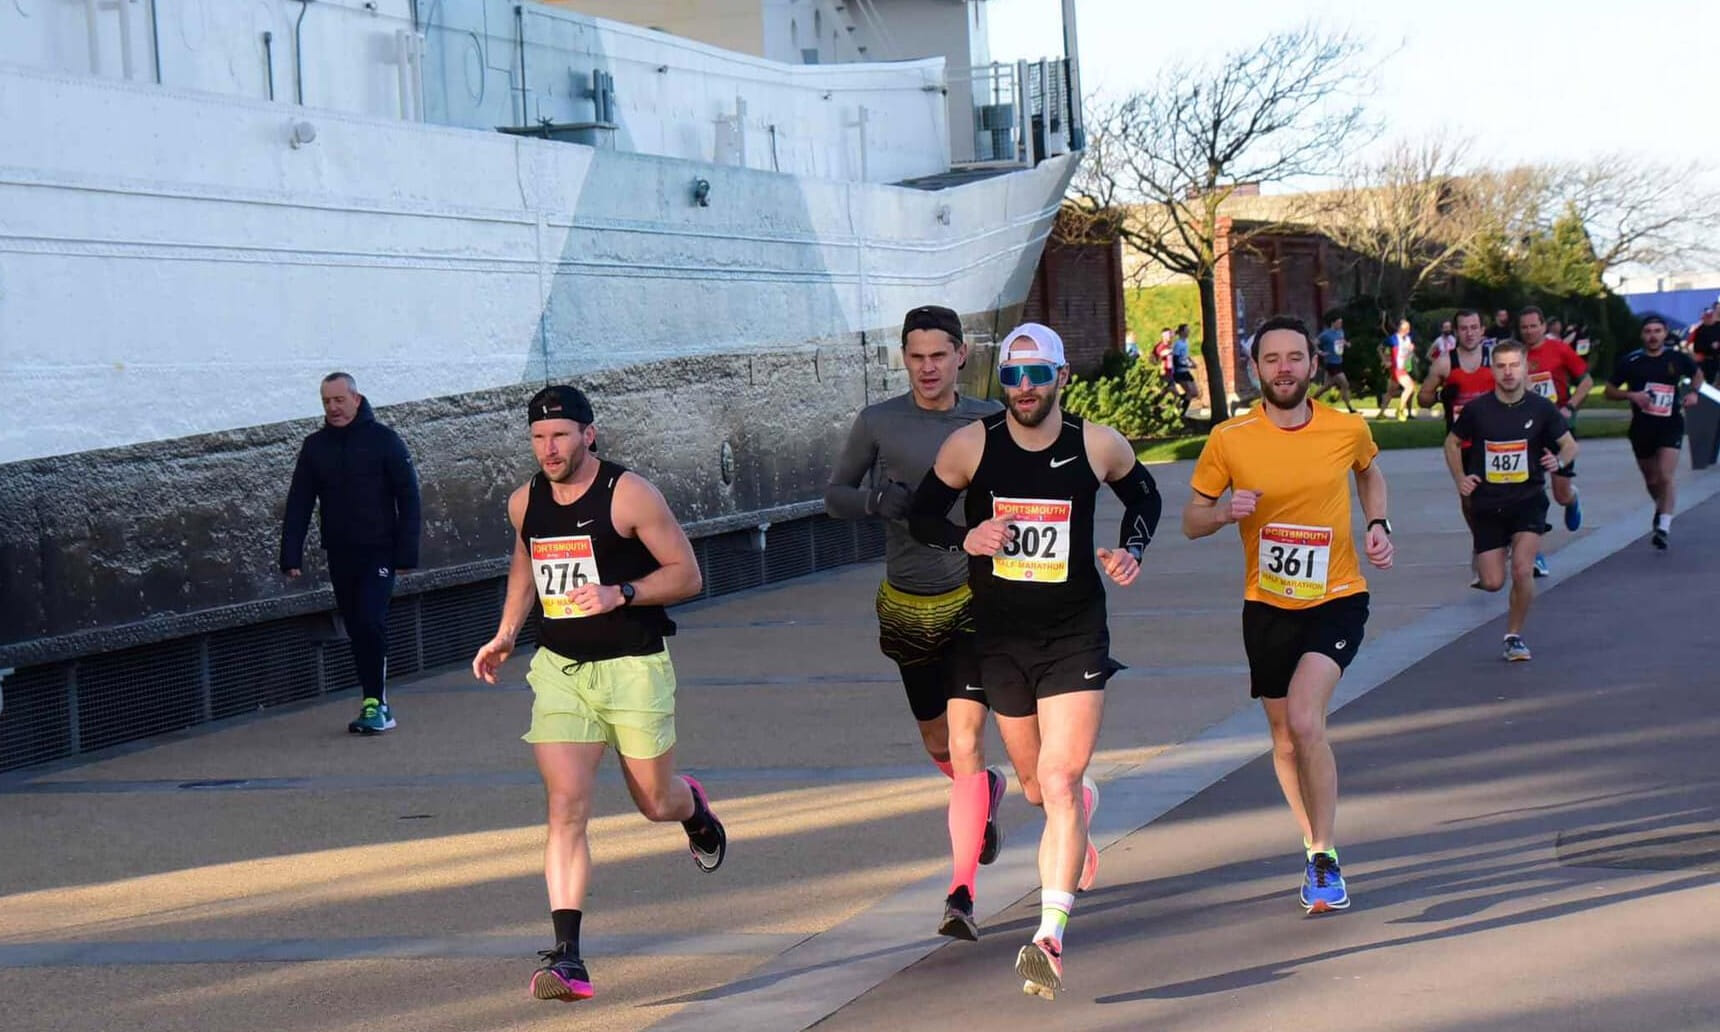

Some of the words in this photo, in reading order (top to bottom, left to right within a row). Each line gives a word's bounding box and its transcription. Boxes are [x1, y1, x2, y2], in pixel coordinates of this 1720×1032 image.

[1491, 453, 1521, 471] 487
[998, 503, 1066, 514] PORTSMOUTH
[1003, 524, 1058, 559] 302
[1265, 527, 1329, 540] PORTSMOUTH
[1018, 562, 1065, 570] MARATHON
[1268, 545, 1315, 578] 361
[540, 562, 589, 596] 276
